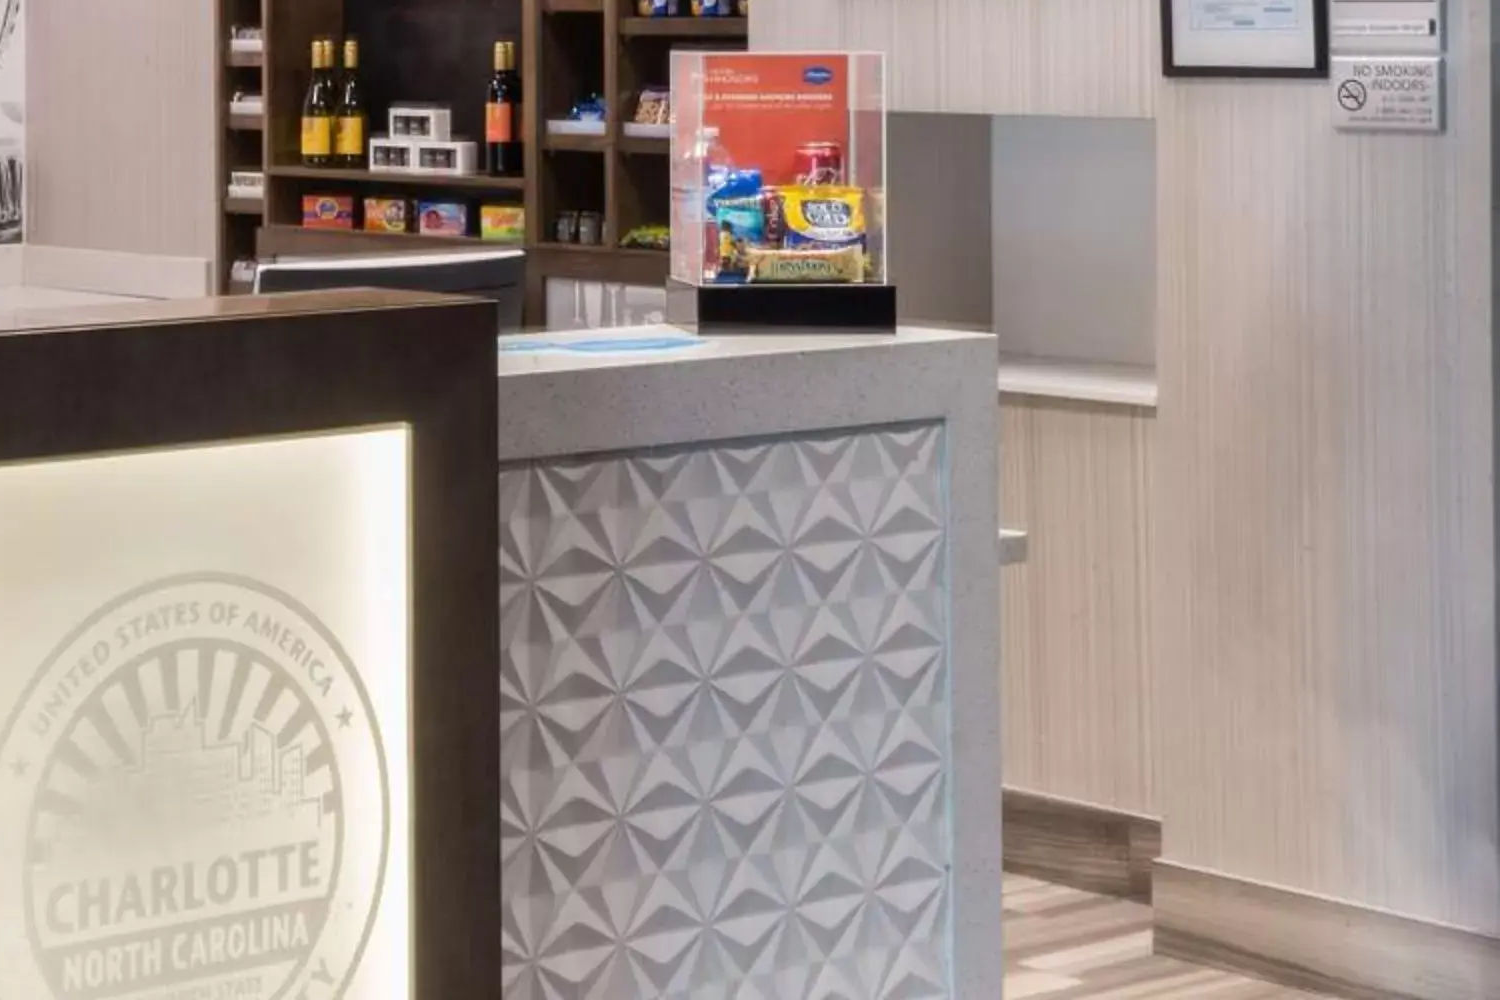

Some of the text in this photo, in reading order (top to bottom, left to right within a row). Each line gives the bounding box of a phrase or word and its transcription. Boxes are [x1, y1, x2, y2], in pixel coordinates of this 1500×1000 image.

[29, 600, 336, 737] UNITED STATES OF AMERICA
[46, 839, 321, 935] CHARLOTTE
[62, 912, 311, 992] NORTH CAROLINA
